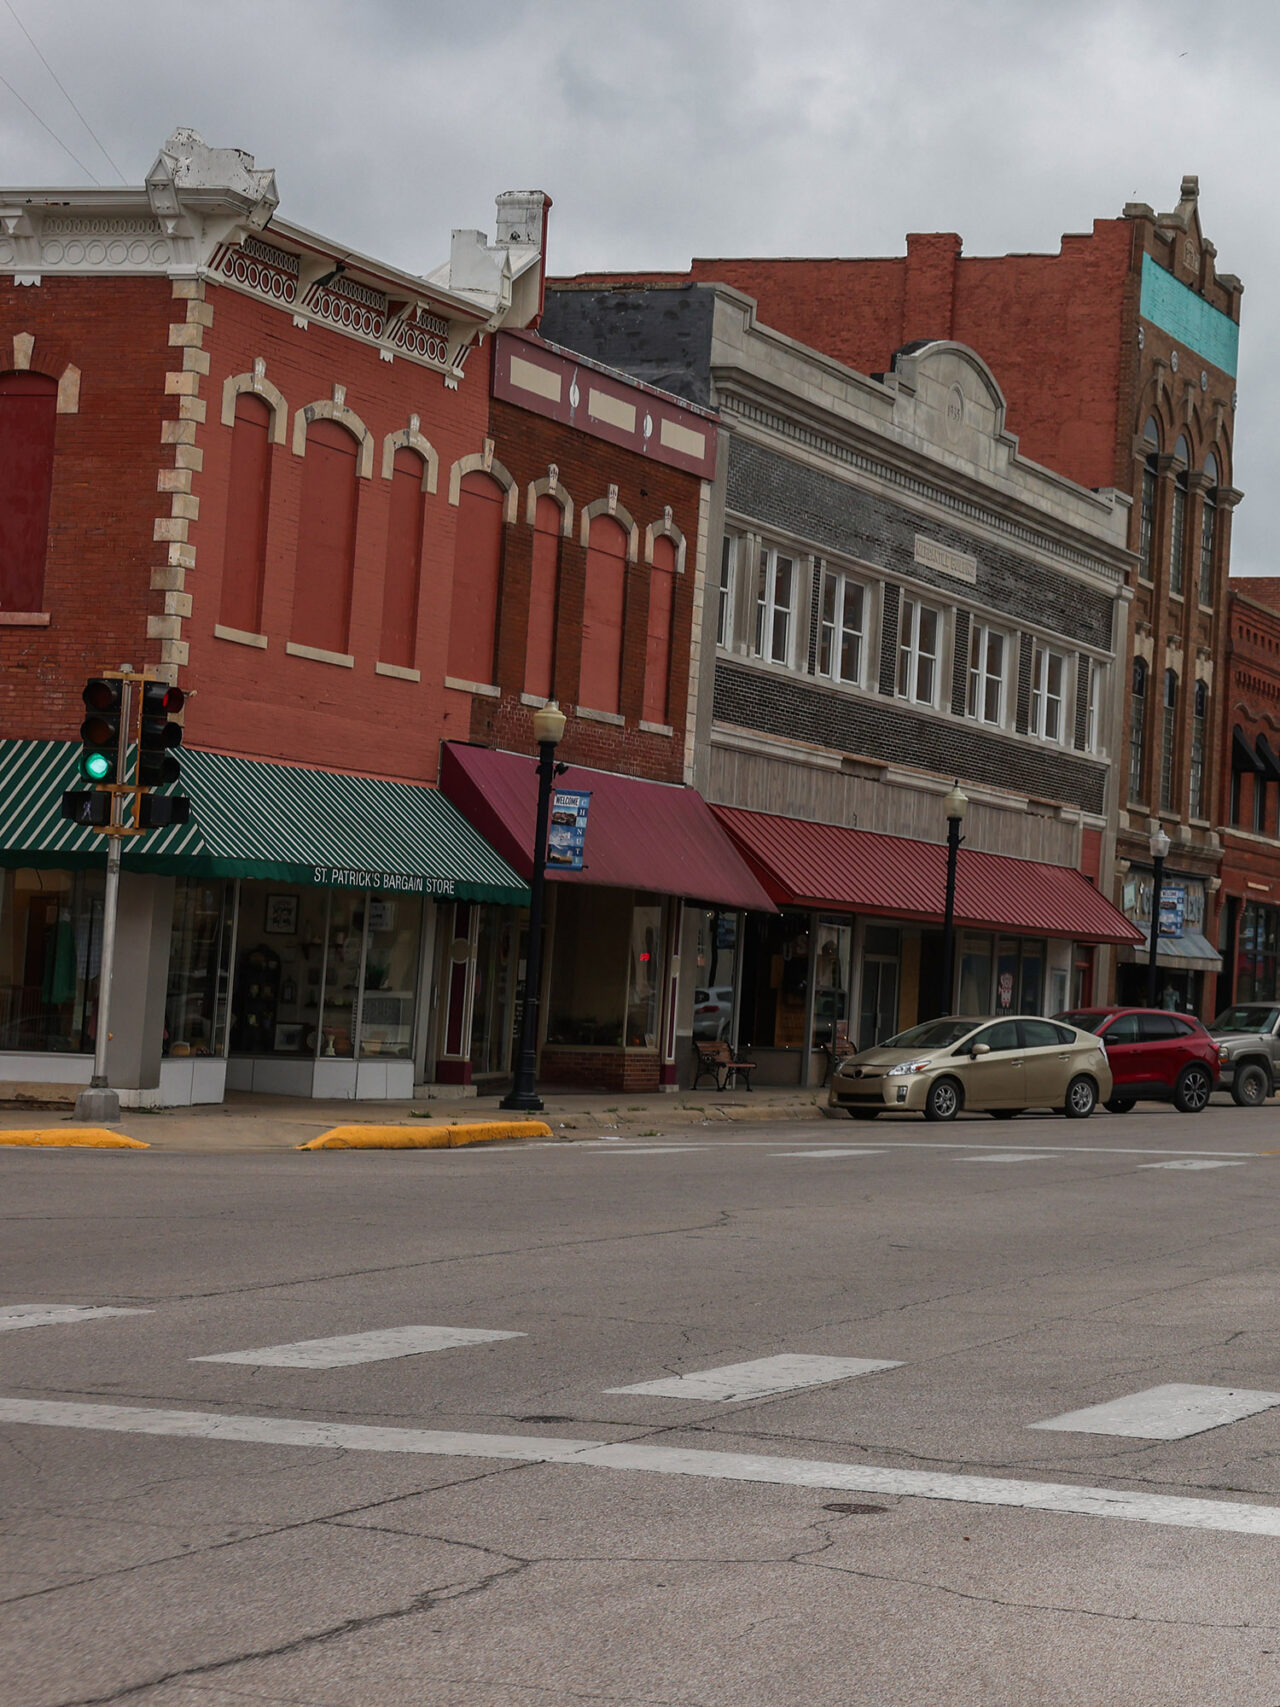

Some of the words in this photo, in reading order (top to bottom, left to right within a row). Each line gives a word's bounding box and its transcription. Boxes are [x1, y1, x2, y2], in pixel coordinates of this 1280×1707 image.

[556, 796, 579, 806] WELCOME
[314, 866, 328, 883] ST.
[331, 868, 381, 888] PATRICK'S
[383, 873, 423, 891] BARGAIN
[426, 878, 455, 894] STORE
